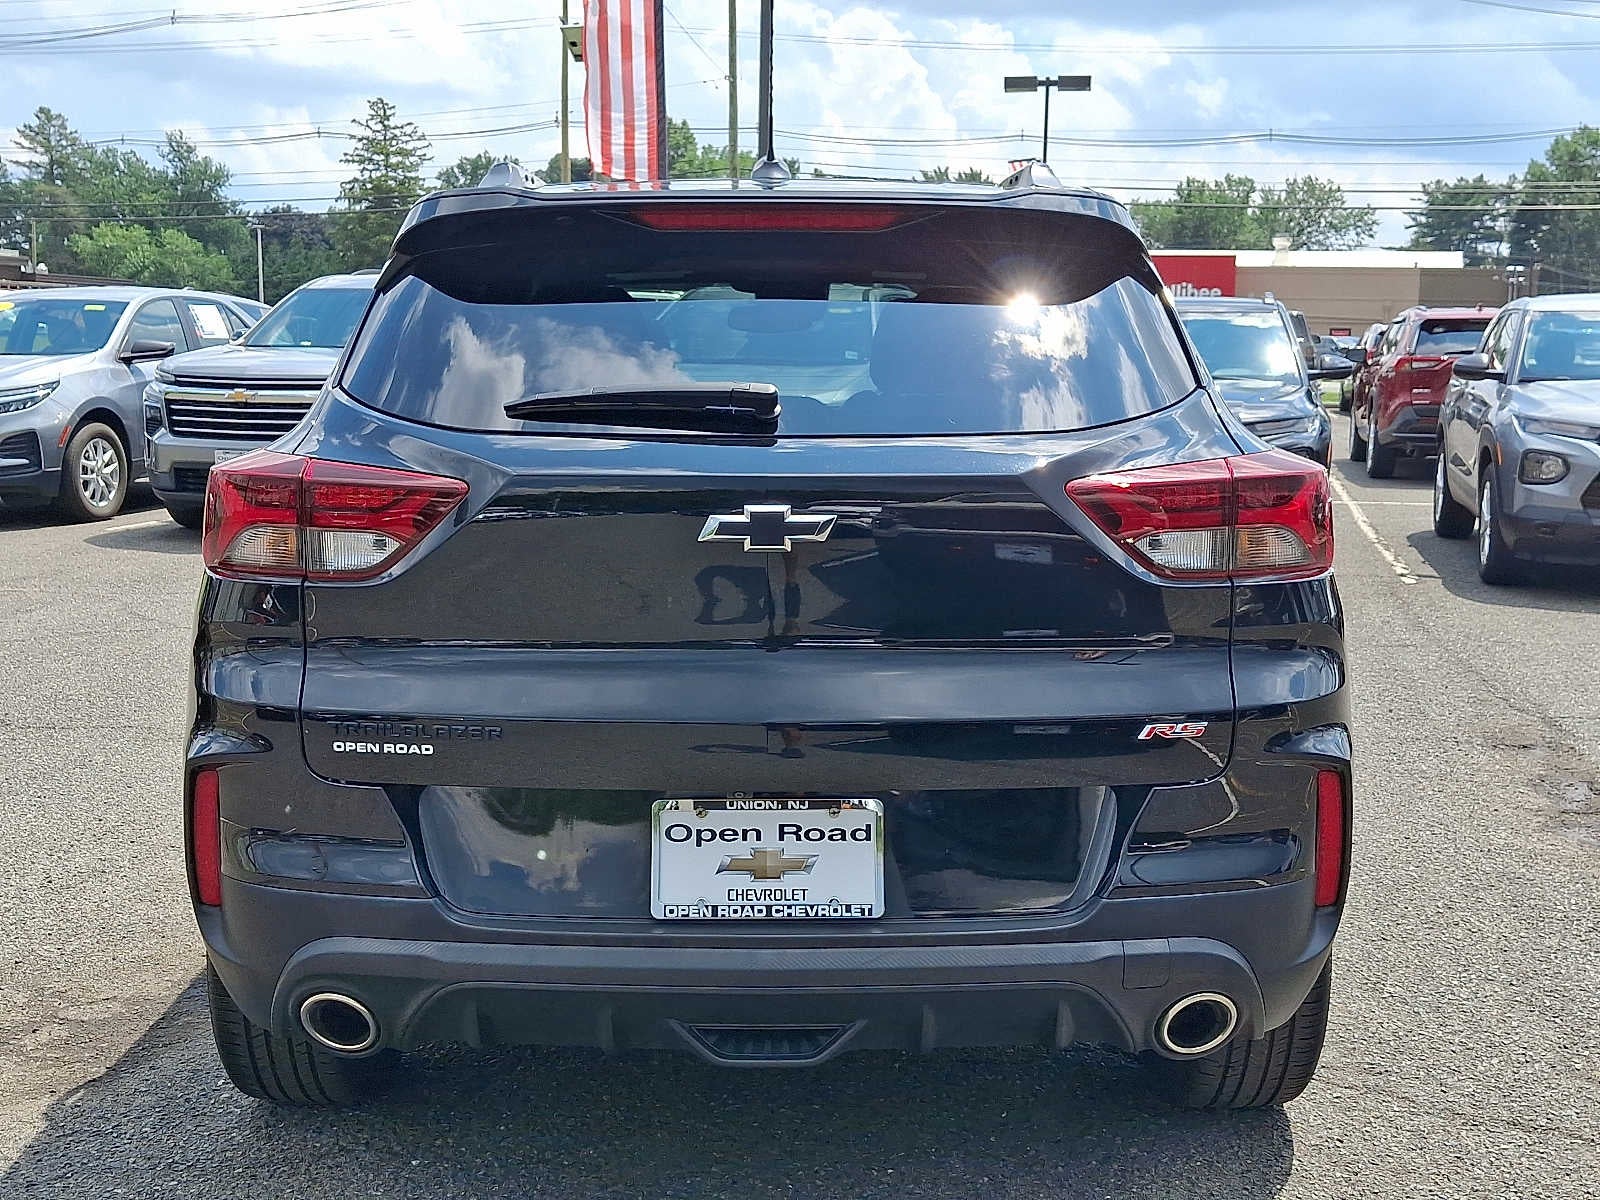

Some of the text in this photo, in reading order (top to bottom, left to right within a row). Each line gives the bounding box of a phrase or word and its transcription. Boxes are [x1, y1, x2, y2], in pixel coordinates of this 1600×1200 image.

[327, 720, 502, 740] TRAILBLAZER
[1138, 721, 1209, 740] RS
[332, 741, 435, 756] OPEN ROAD
[725, 800, 810, 811] UNION, NJ
[664, 823, 873, 848] Open Road
[726, 888, 809, 902] CHEVROLET
[665, 904, 872, 918] OPEN ROAD CHEVROLET
